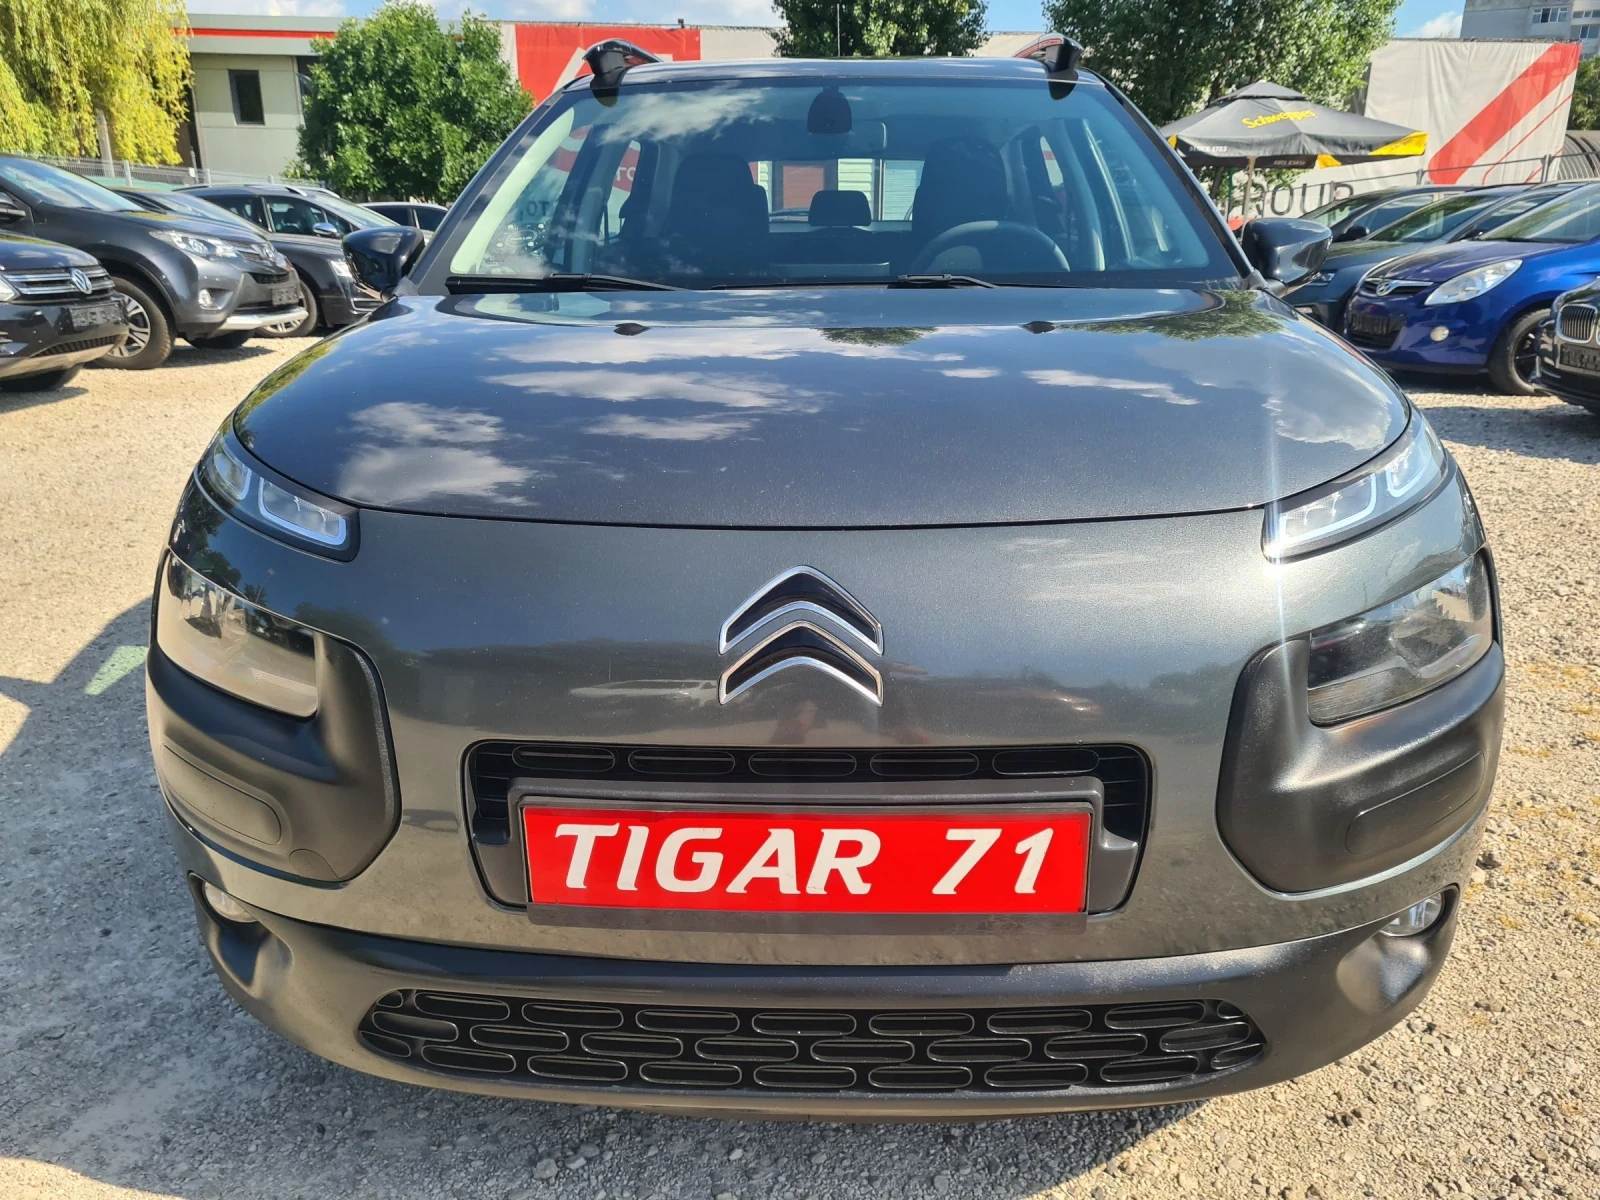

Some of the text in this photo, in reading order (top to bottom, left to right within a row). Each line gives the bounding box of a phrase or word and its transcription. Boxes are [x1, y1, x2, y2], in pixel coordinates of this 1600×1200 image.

[1241, 109, 1317, 129] Schweppes
[554, 823, 1054, 895] TIGAR 71
